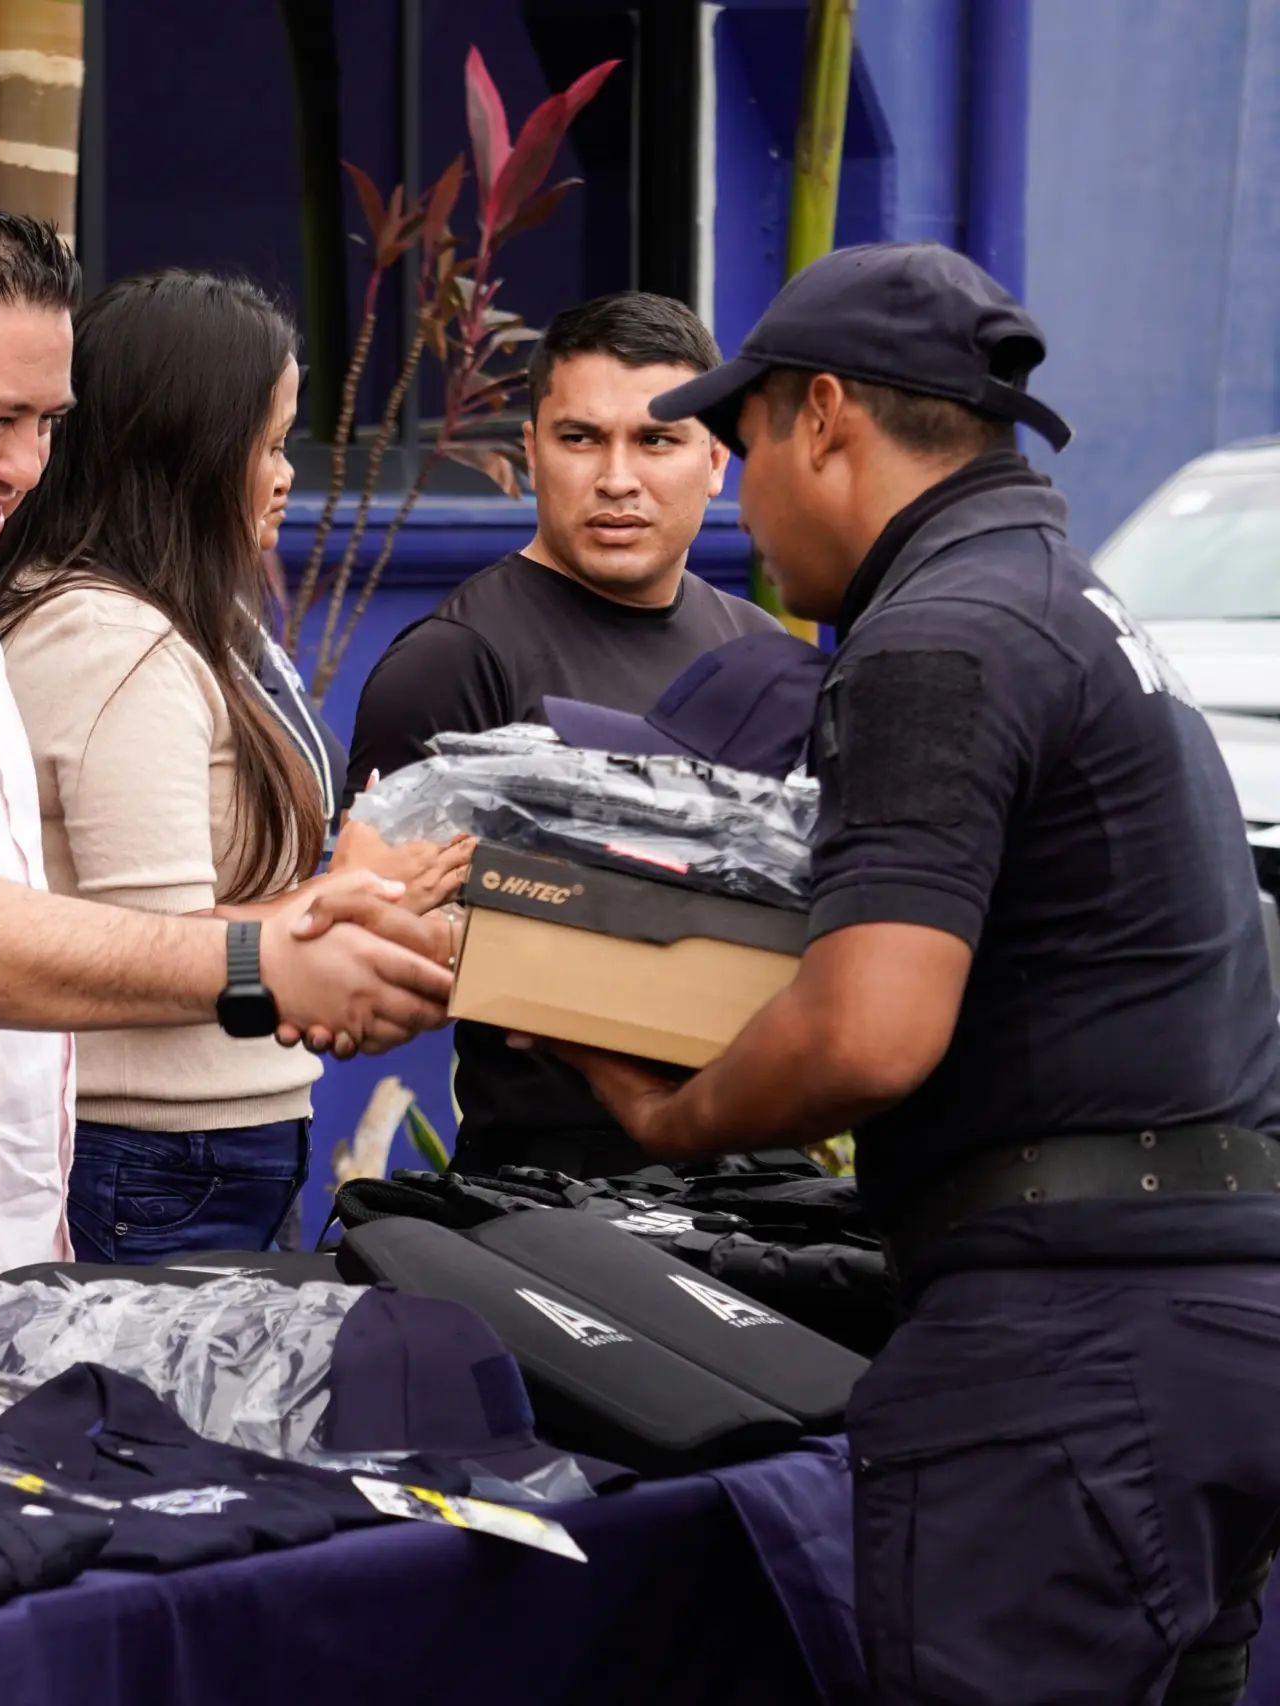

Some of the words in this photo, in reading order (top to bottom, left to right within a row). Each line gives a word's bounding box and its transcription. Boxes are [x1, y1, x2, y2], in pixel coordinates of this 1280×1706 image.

[500, 876, 572, 904] HI-TEC
[728, 1315, 784, 1328] TACTICAL
[580, 1332, 633, 1347] TACTICAL
